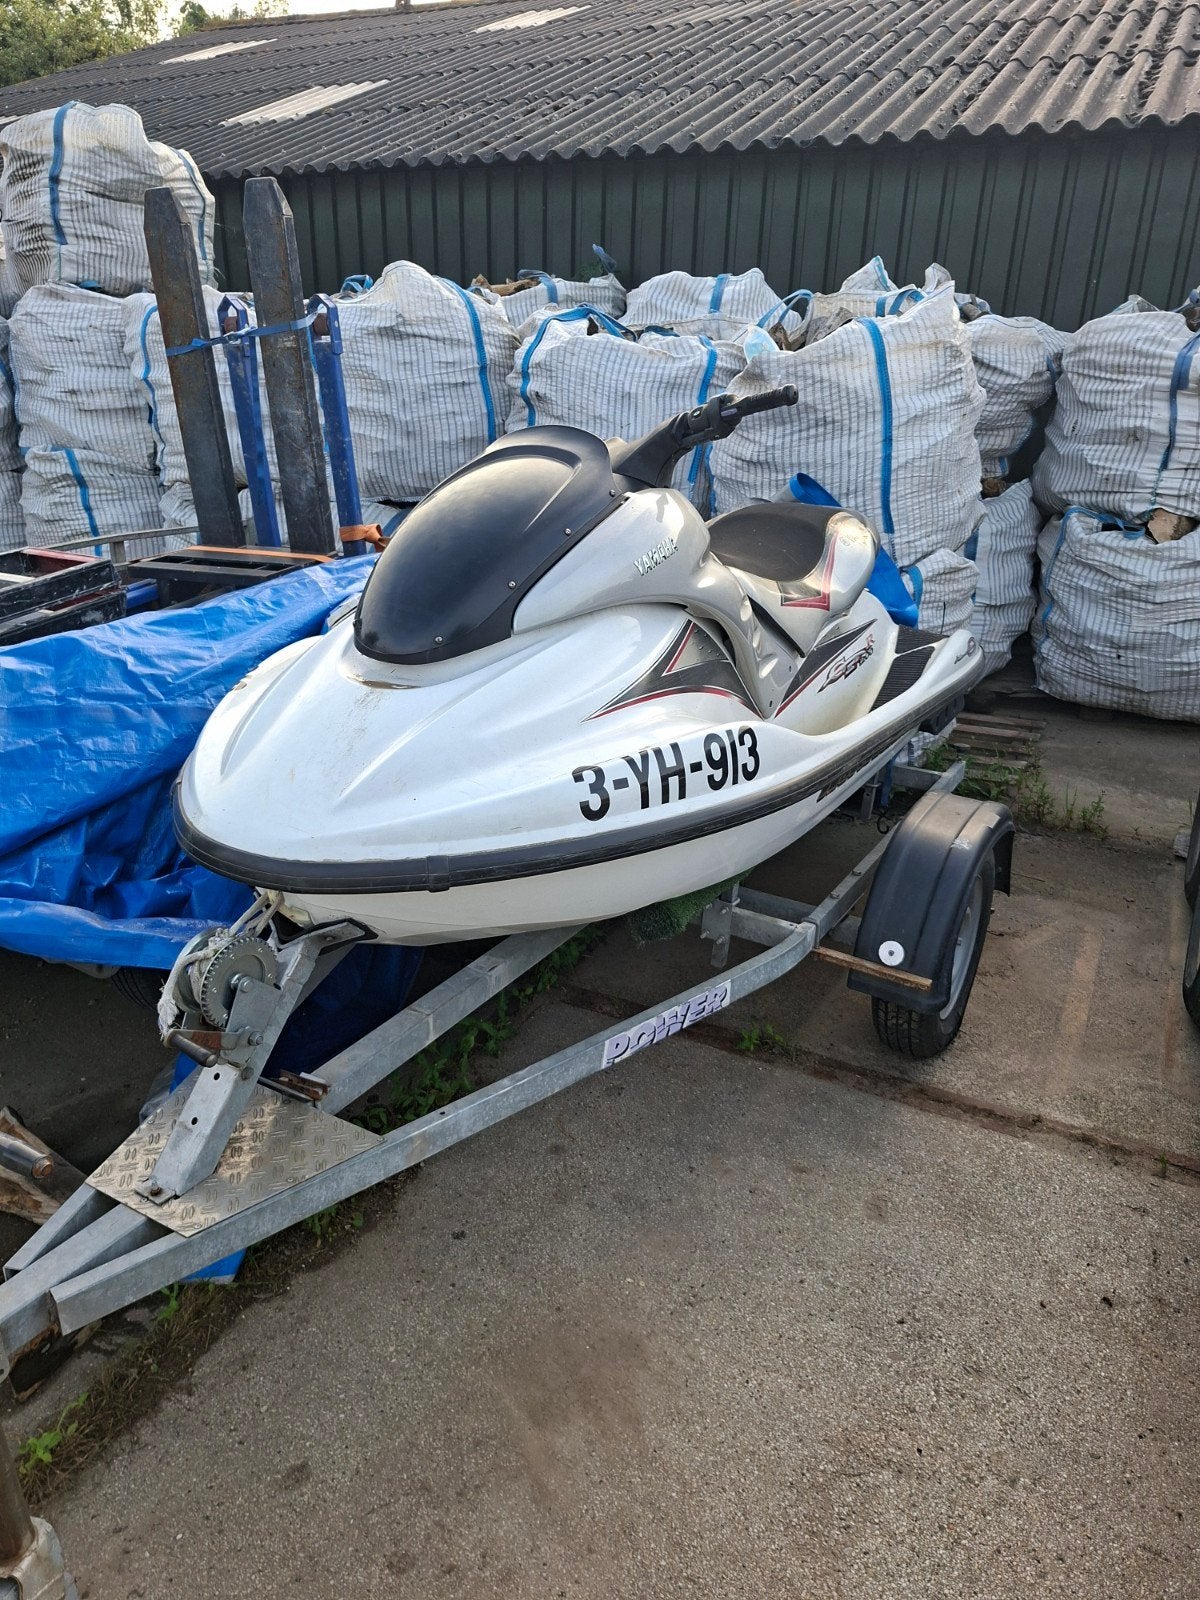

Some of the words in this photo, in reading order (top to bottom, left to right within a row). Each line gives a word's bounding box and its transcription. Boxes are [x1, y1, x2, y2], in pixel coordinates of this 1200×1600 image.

[633, 536, 679, 577] YAMAHA
[571, 725, 760, 822] 3-YH-913
[604, 982, 729, 1067] POWER
